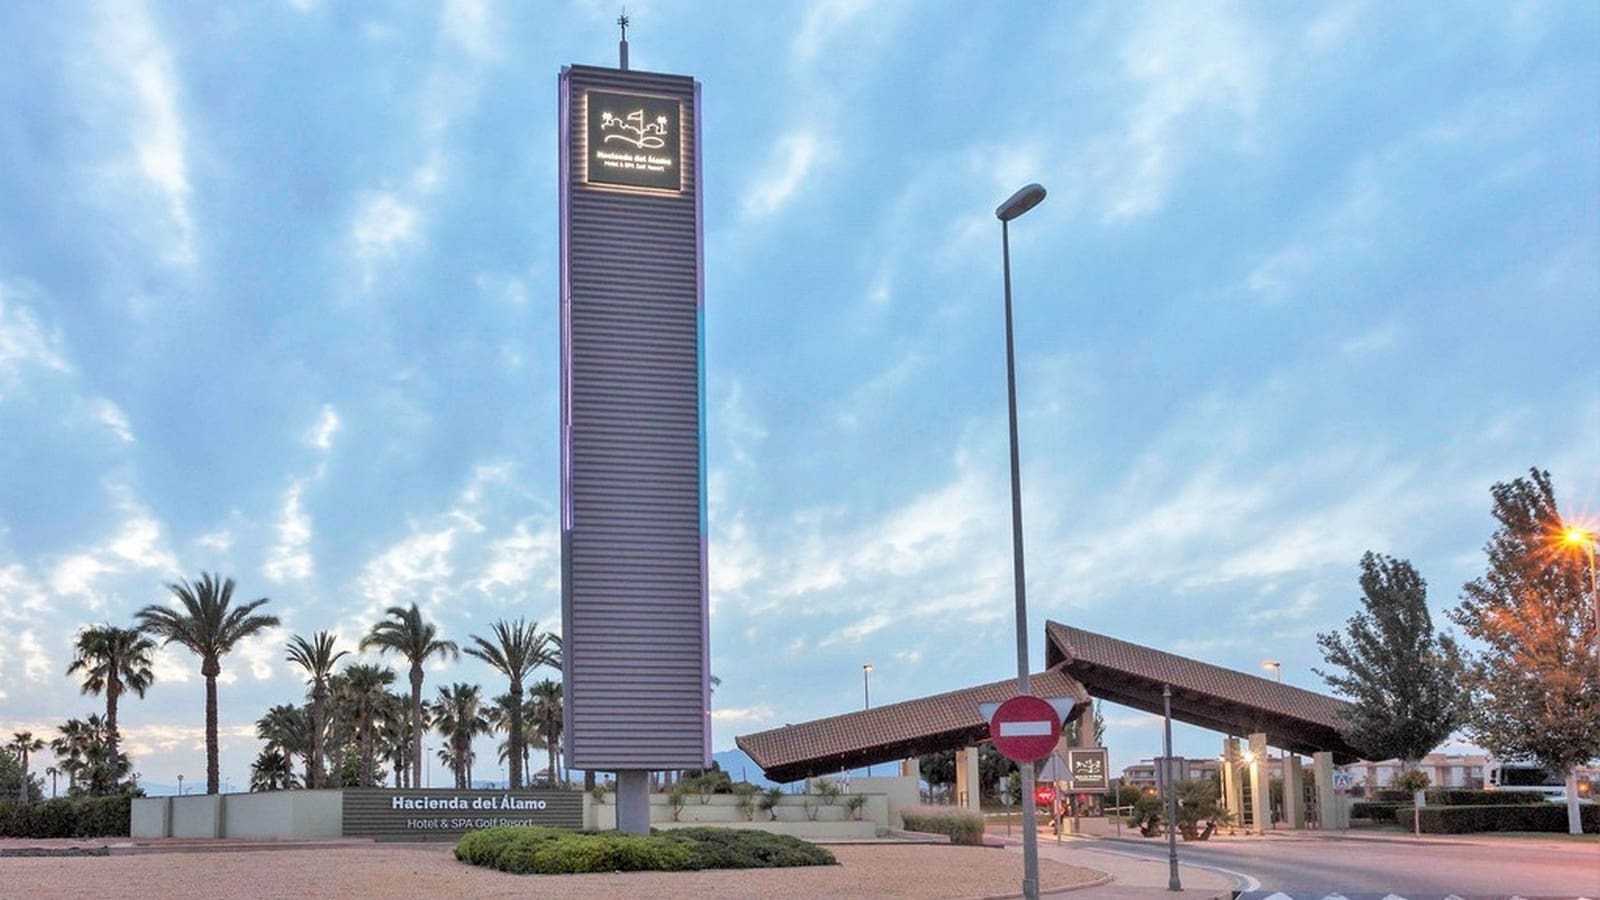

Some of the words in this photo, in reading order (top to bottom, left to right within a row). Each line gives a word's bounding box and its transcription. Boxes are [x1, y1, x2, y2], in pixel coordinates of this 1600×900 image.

[392, 796, 469, 809] Hacienda
[472, 796, 498, 809] del
[500, 793, 546, 809] Álamo
[407, 818, 438, 829] Hotel
[440, 818, 449, 829] &
[451, 818, 474, 829] SPA
[475, 818, 497, 828] Golf
[499, 819, 533, 828] Resort
